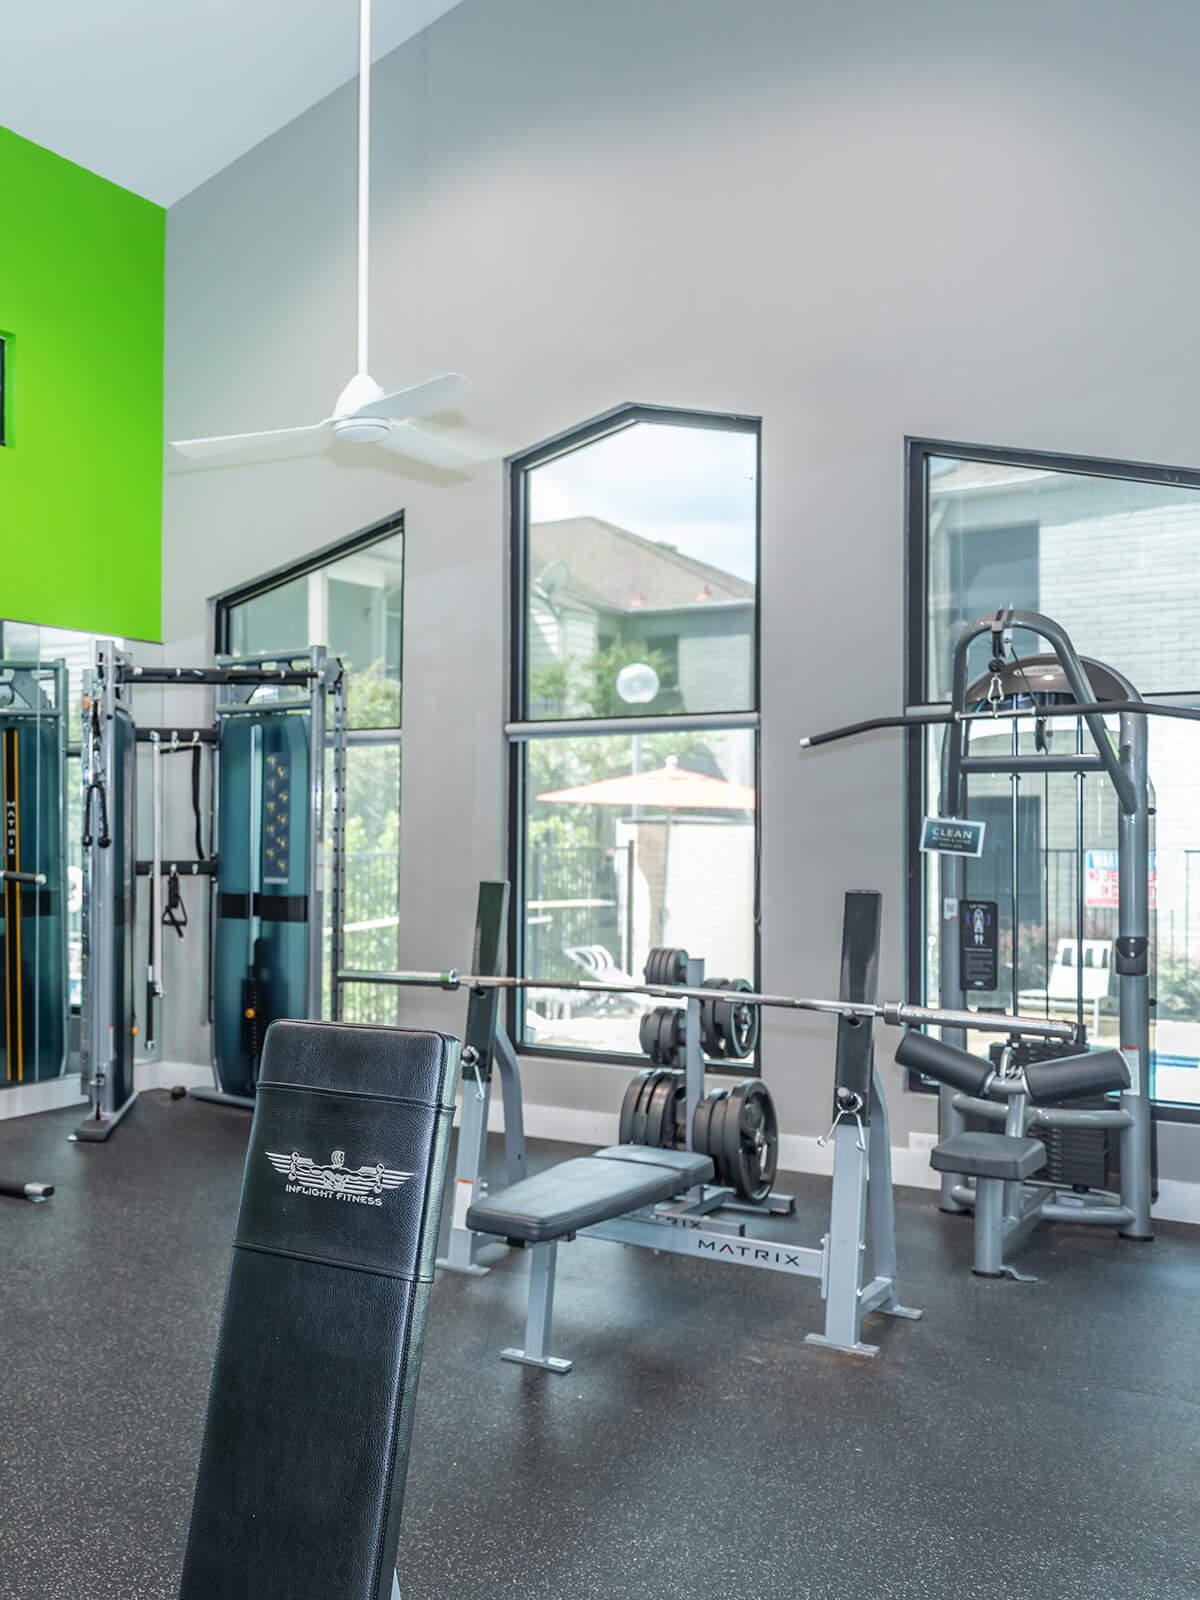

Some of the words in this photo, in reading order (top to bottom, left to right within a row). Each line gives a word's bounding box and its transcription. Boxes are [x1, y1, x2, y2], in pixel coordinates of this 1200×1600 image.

[932, 827, 973, 840] CLEAN
[285, 1184, 334, 1199] INFLIGHT
[335, 1192, 383, 1206] FITNESS
[698, 1239, 800, 1266] MATRIX
